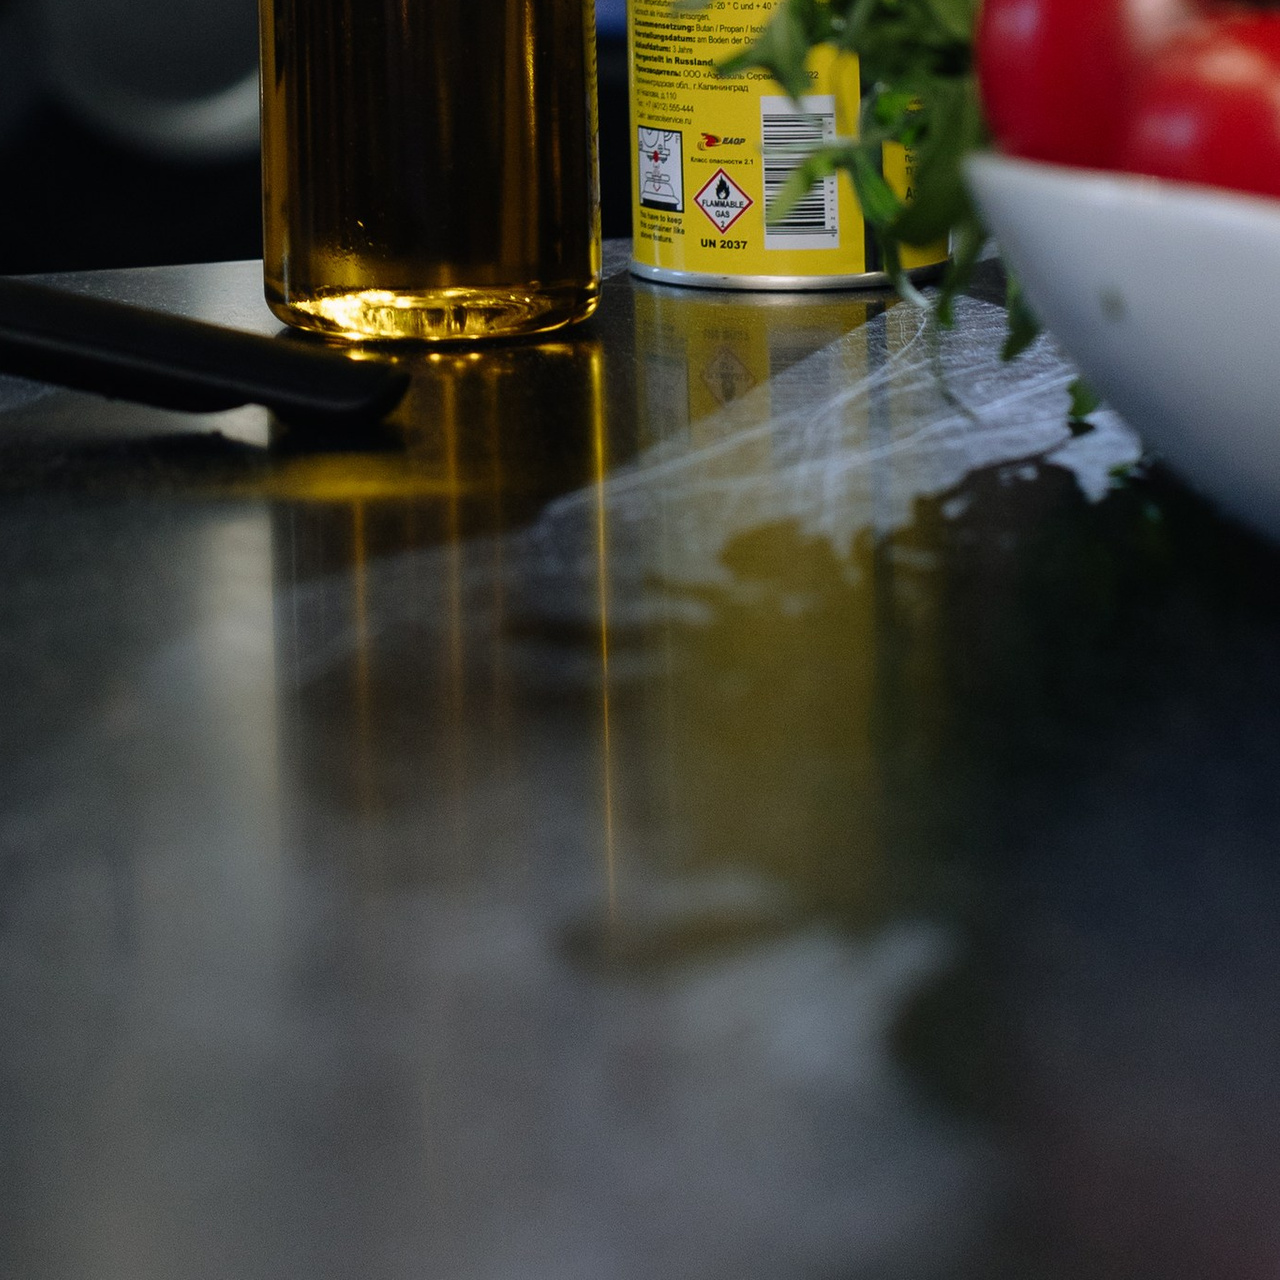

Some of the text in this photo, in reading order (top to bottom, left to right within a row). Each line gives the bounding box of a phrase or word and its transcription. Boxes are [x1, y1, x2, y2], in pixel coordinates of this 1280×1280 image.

[696, 23, 744, 32] Butan Propan
[708, 35, 729, 44] Boden
[731, 36, 742, 45] der
[683, 69, 701, 77] ООО
[701, 200, 744, 209] FLAMMABLE
[715, 210, 730, 218] GAS
[667, 215, 682, 225] keep
[720, 220, 726, 229] 2
[701, 238, 747, 249] UN 2037
